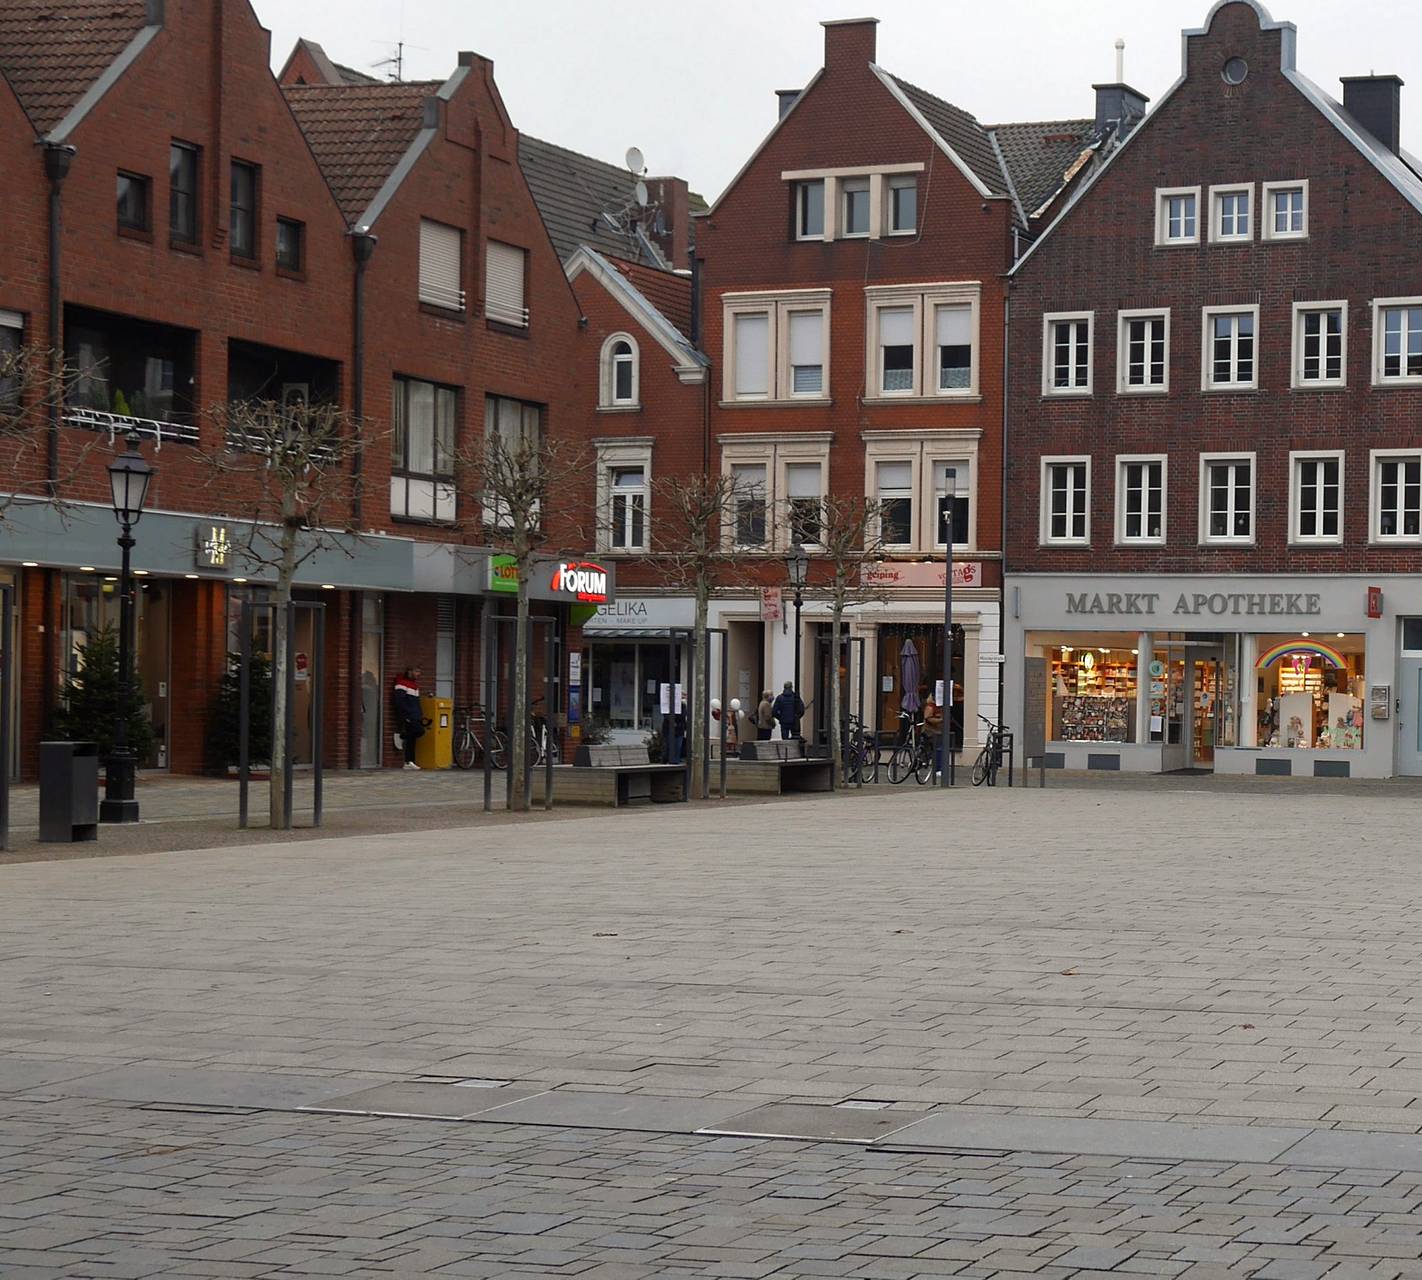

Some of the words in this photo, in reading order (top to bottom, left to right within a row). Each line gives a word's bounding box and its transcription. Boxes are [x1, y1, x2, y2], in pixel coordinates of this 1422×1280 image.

[559, 563, 606, 594] FORUM
[597, 602, 648, 616] GELIKA
[1066, 593, 1160, 615] MARKT
[1173, 593, 1322, 615] APOTHEKE
